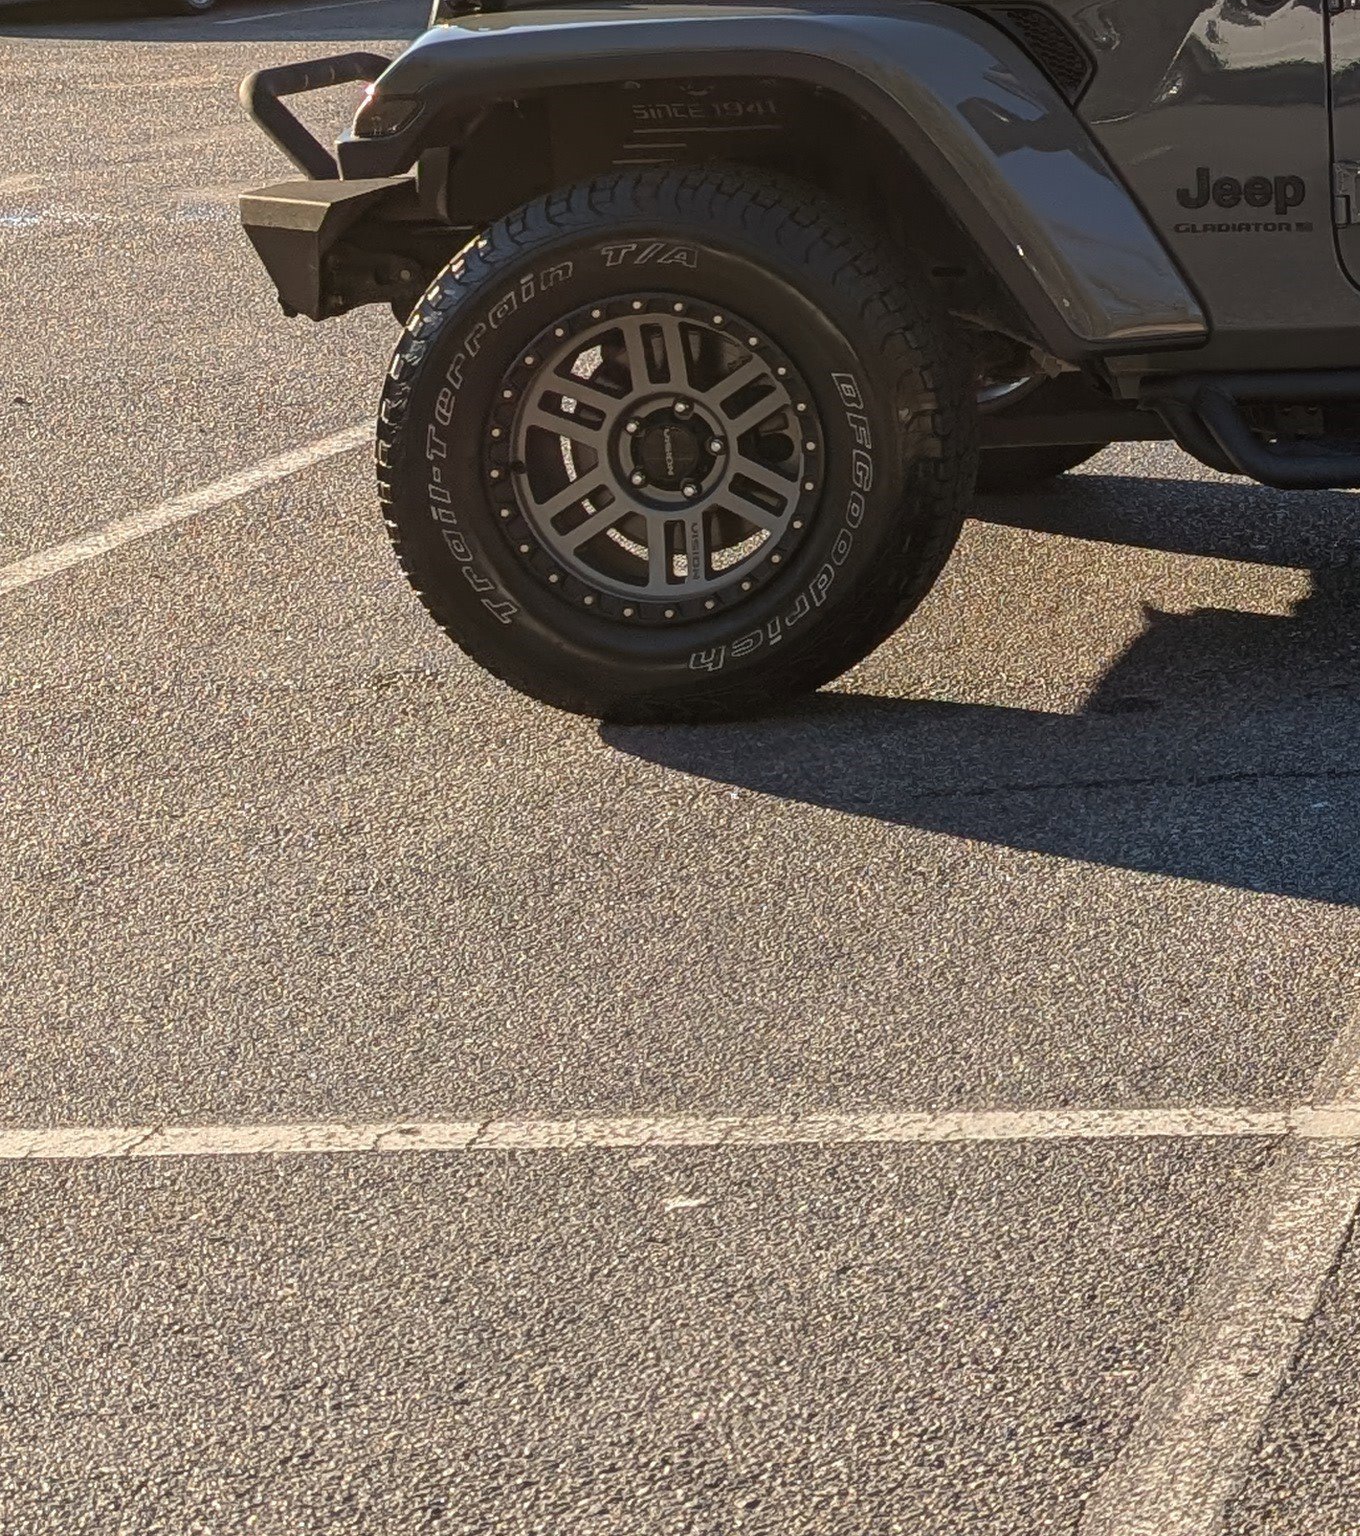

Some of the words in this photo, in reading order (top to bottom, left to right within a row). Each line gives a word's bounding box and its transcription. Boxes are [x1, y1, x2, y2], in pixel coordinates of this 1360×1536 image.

[712, 99, 777, 117] 1941
[1176, 167, 1306, 215] Jeep
[1173, 222, 1292, 234] GLADIATOR
[425, 261, 573, 624] Trail-Terrain
[601, 242, 699, 268] T/A
[689, 372, 873, 672] BFGoodrich
[690, 522, 701, 580] VISION
